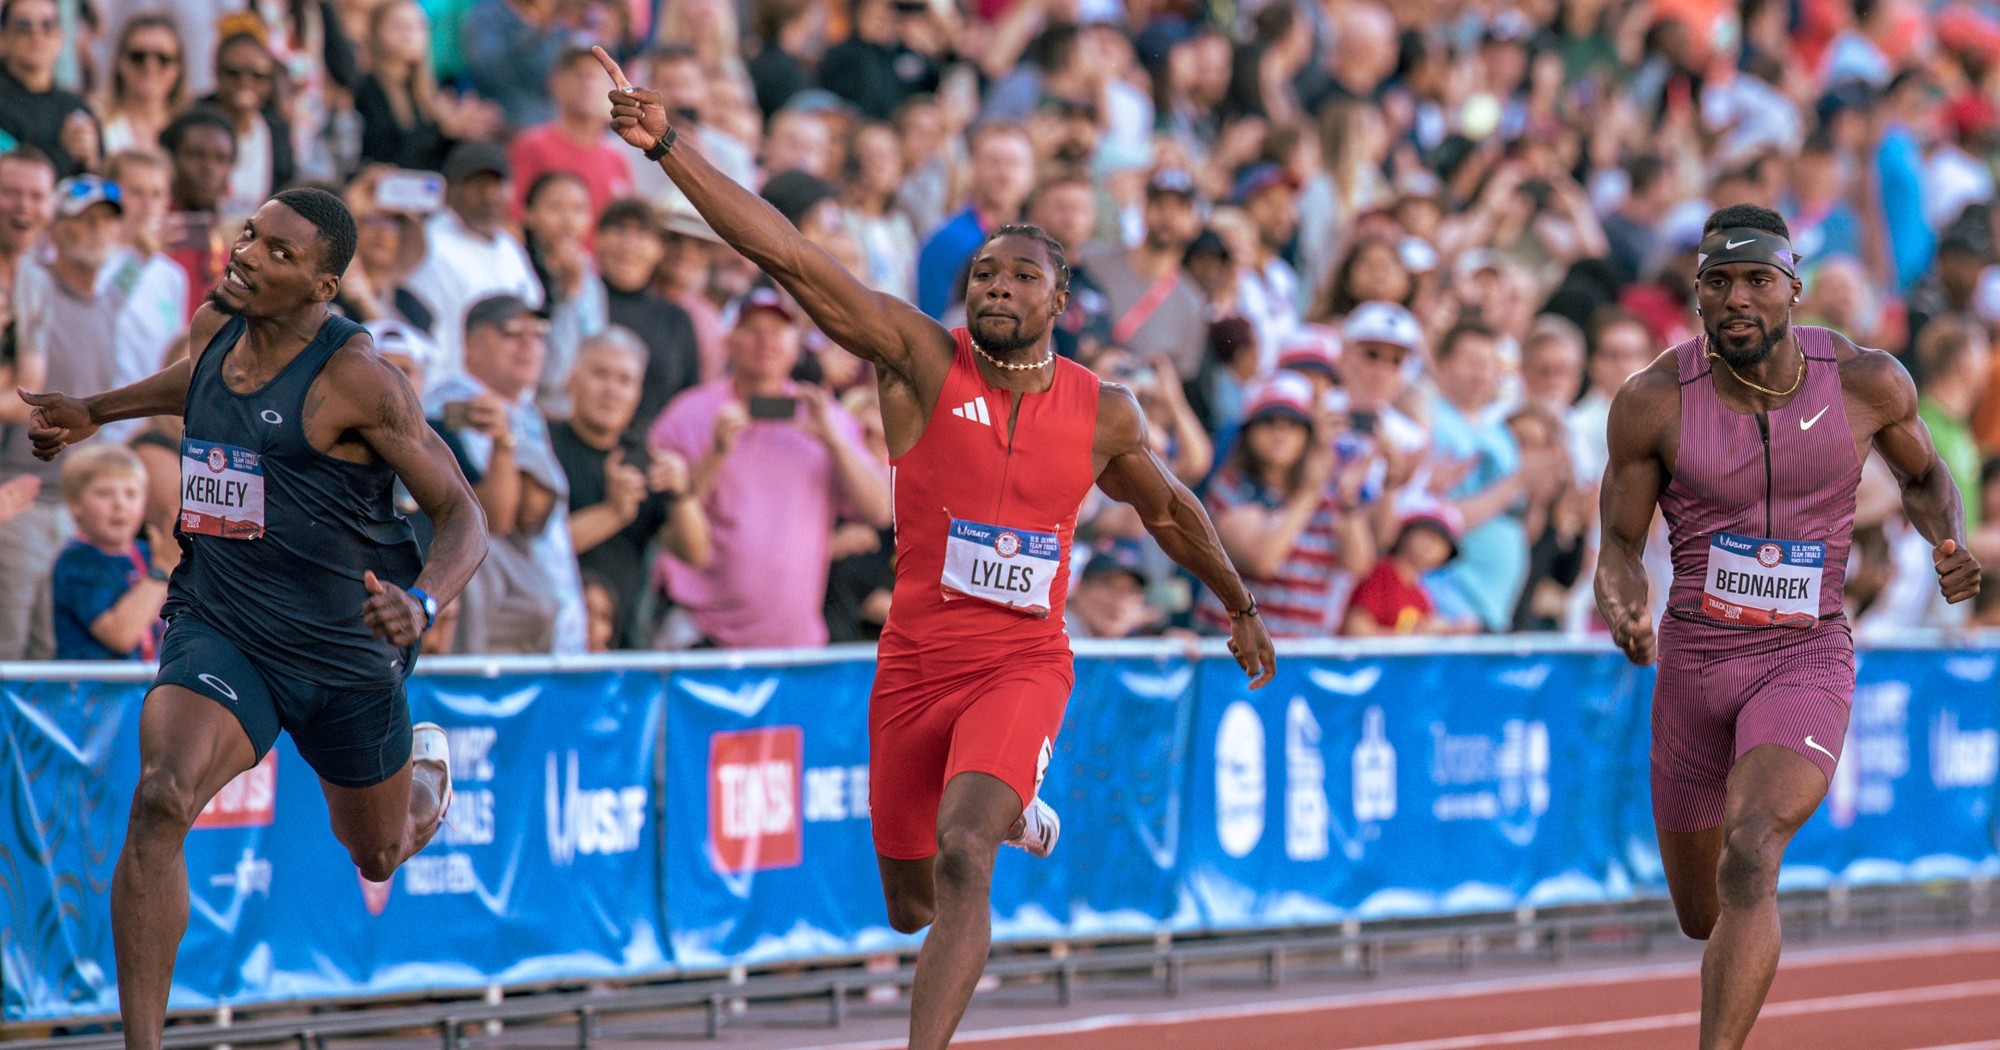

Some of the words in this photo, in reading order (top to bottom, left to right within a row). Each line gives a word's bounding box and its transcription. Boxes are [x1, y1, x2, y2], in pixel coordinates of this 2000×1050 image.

[185, 474, 248, 508] KERLEY
[967, 529, 990, 538] USATF
[1030, 535, 1039, 543] U.S.
[1029, 542, 1043, 550] TEAM
[1043, 543, 1058, 551] TRIALS
[1728, 541, 1752, 551] USATF
[970, 558, 1034, 593] LYLES
[1715, 568, 1811, 600] BEDNAREK
[1724, 611, 1740, 620] 2024
